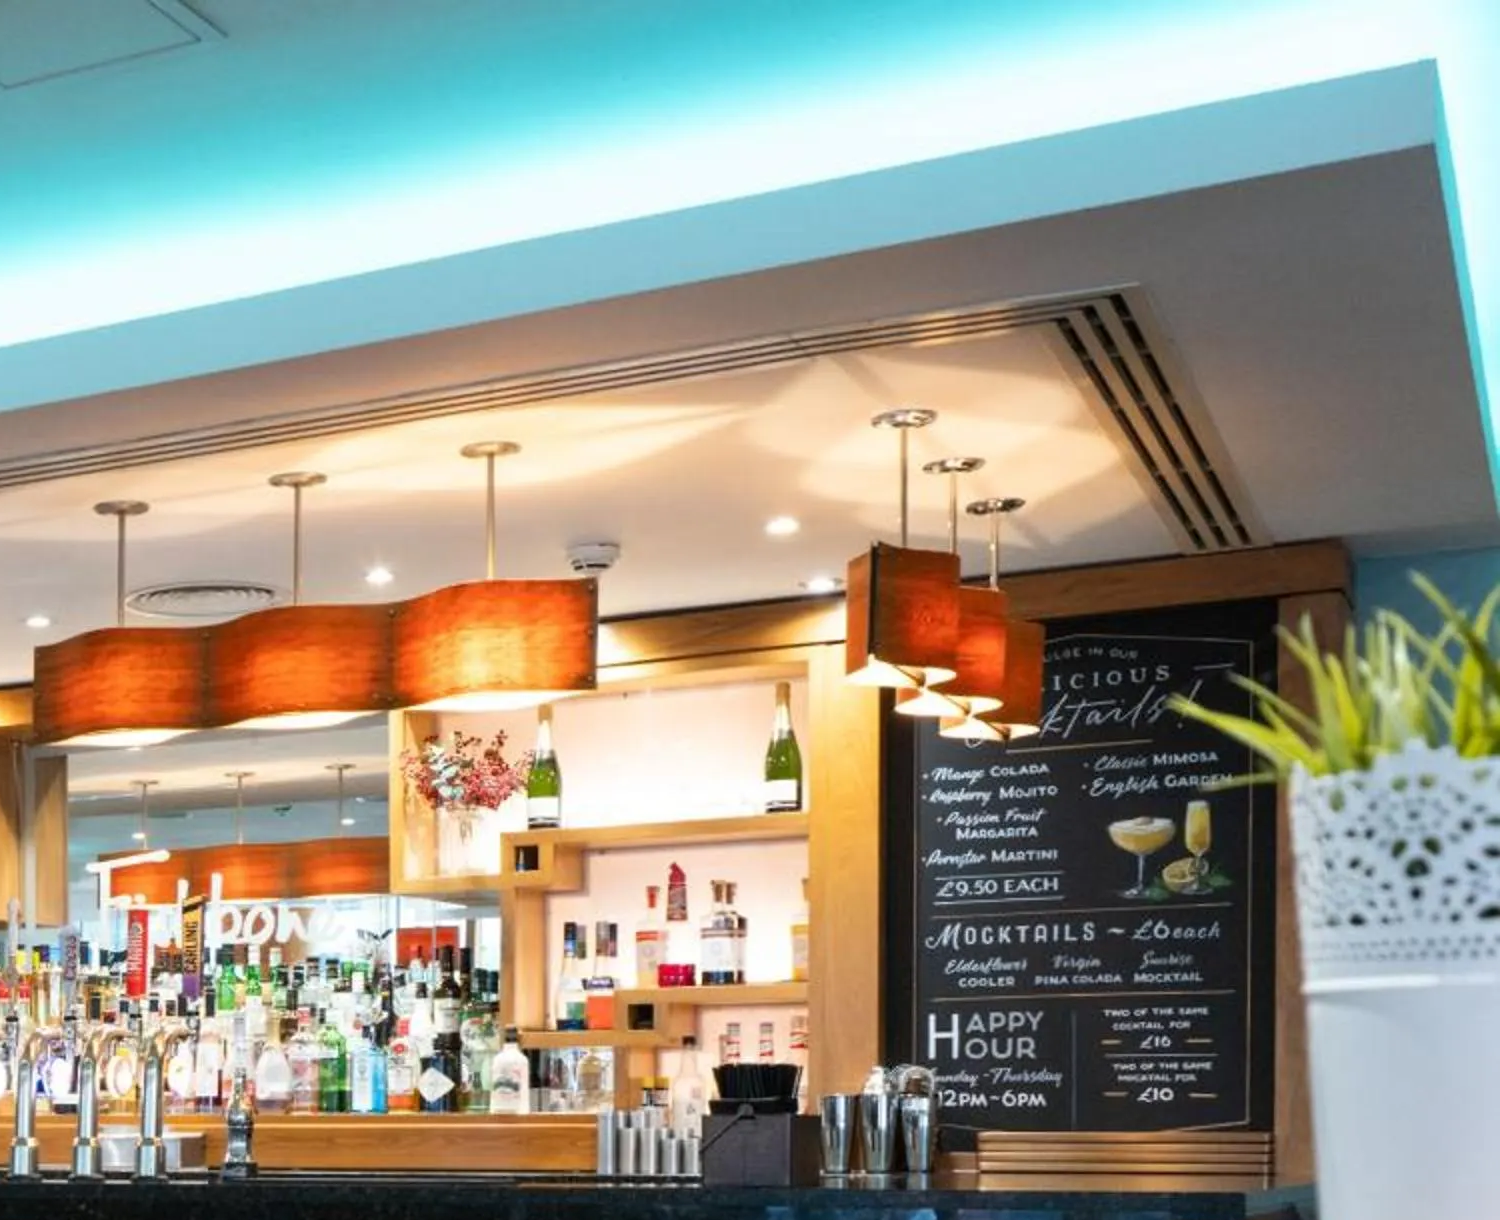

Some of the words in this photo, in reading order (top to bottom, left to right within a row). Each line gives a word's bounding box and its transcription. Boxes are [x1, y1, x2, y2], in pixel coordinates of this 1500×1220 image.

[1088, 647, 1103, 657] IN
[1109, 647, 1139, 660] OUR
[1051, 664, 1172, 691] ICIOUS
[1094, 753, 1149, 772] Classic
[1152, 751, 1219, 765] MIMOSA
[931, 767, 985, 785] Mango
[989, 763, 1050, 778] COLADA
[999, 785, 1059, 799] MOJITO
[1089, 774, 1160, 799] English
[943, 811, 1000, 826] Passion
[1004, 807, 1047, 822] Fruit
[955, 826, 1039, 841] MARGARITA
[991, 849, 1059, 863] MARTINI
[935, 878, 999, 898] £9.50
[1003, 877, 1059, 894] EACH
[925, 921, 1097, 951] MOCKTAILS
[183, 920, 198, 974] CARLING
[958, 976, 1016, 988] COOLER
[1133, 971, 1205, 984] MOCKTAIL
[1136, 1086, 1175, 1103] £10
